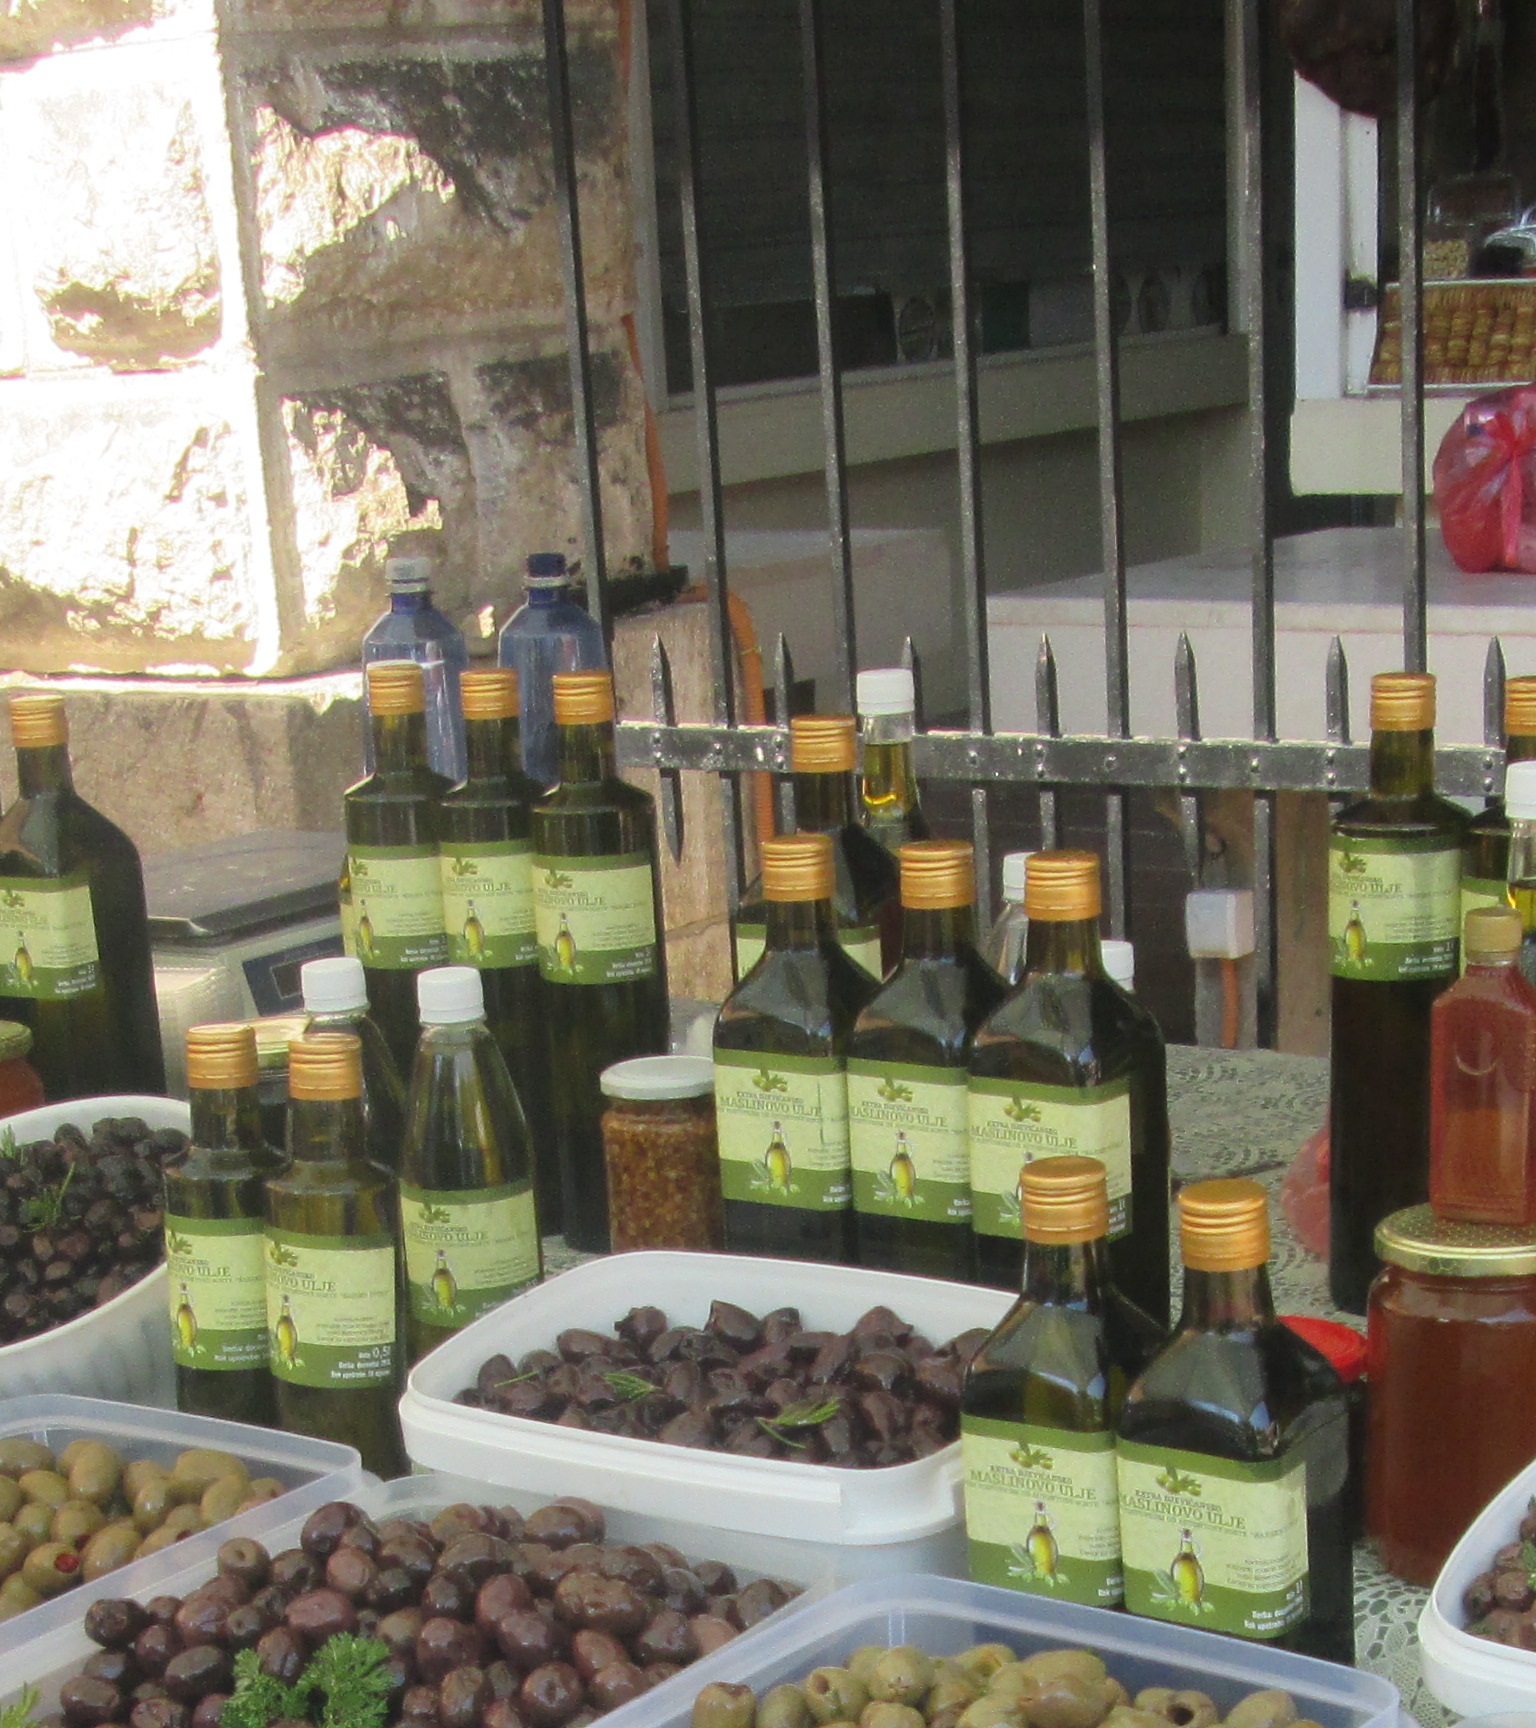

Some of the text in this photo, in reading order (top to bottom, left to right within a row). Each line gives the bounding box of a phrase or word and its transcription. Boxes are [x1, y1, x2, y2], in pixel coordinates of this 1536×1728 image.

[719, 1096, 789, 1115] MASLINOVO
[917, 1112, 948, 1126] ULJE
[970, 1125, 1078, 1150] MASLINOVO ULJE
[197, 1265, 231, 1278] ULJE
[301, 1279, 337, 1293] ULJE
[989, 1464, 1016, 1476] EXTRA
[969, 1469, 1097, 1501] MASLINOVO ULJE
[1134, 1489, 1162, 1501] EXTRA
[1206, 1512, 1246, 1530] ULJE
